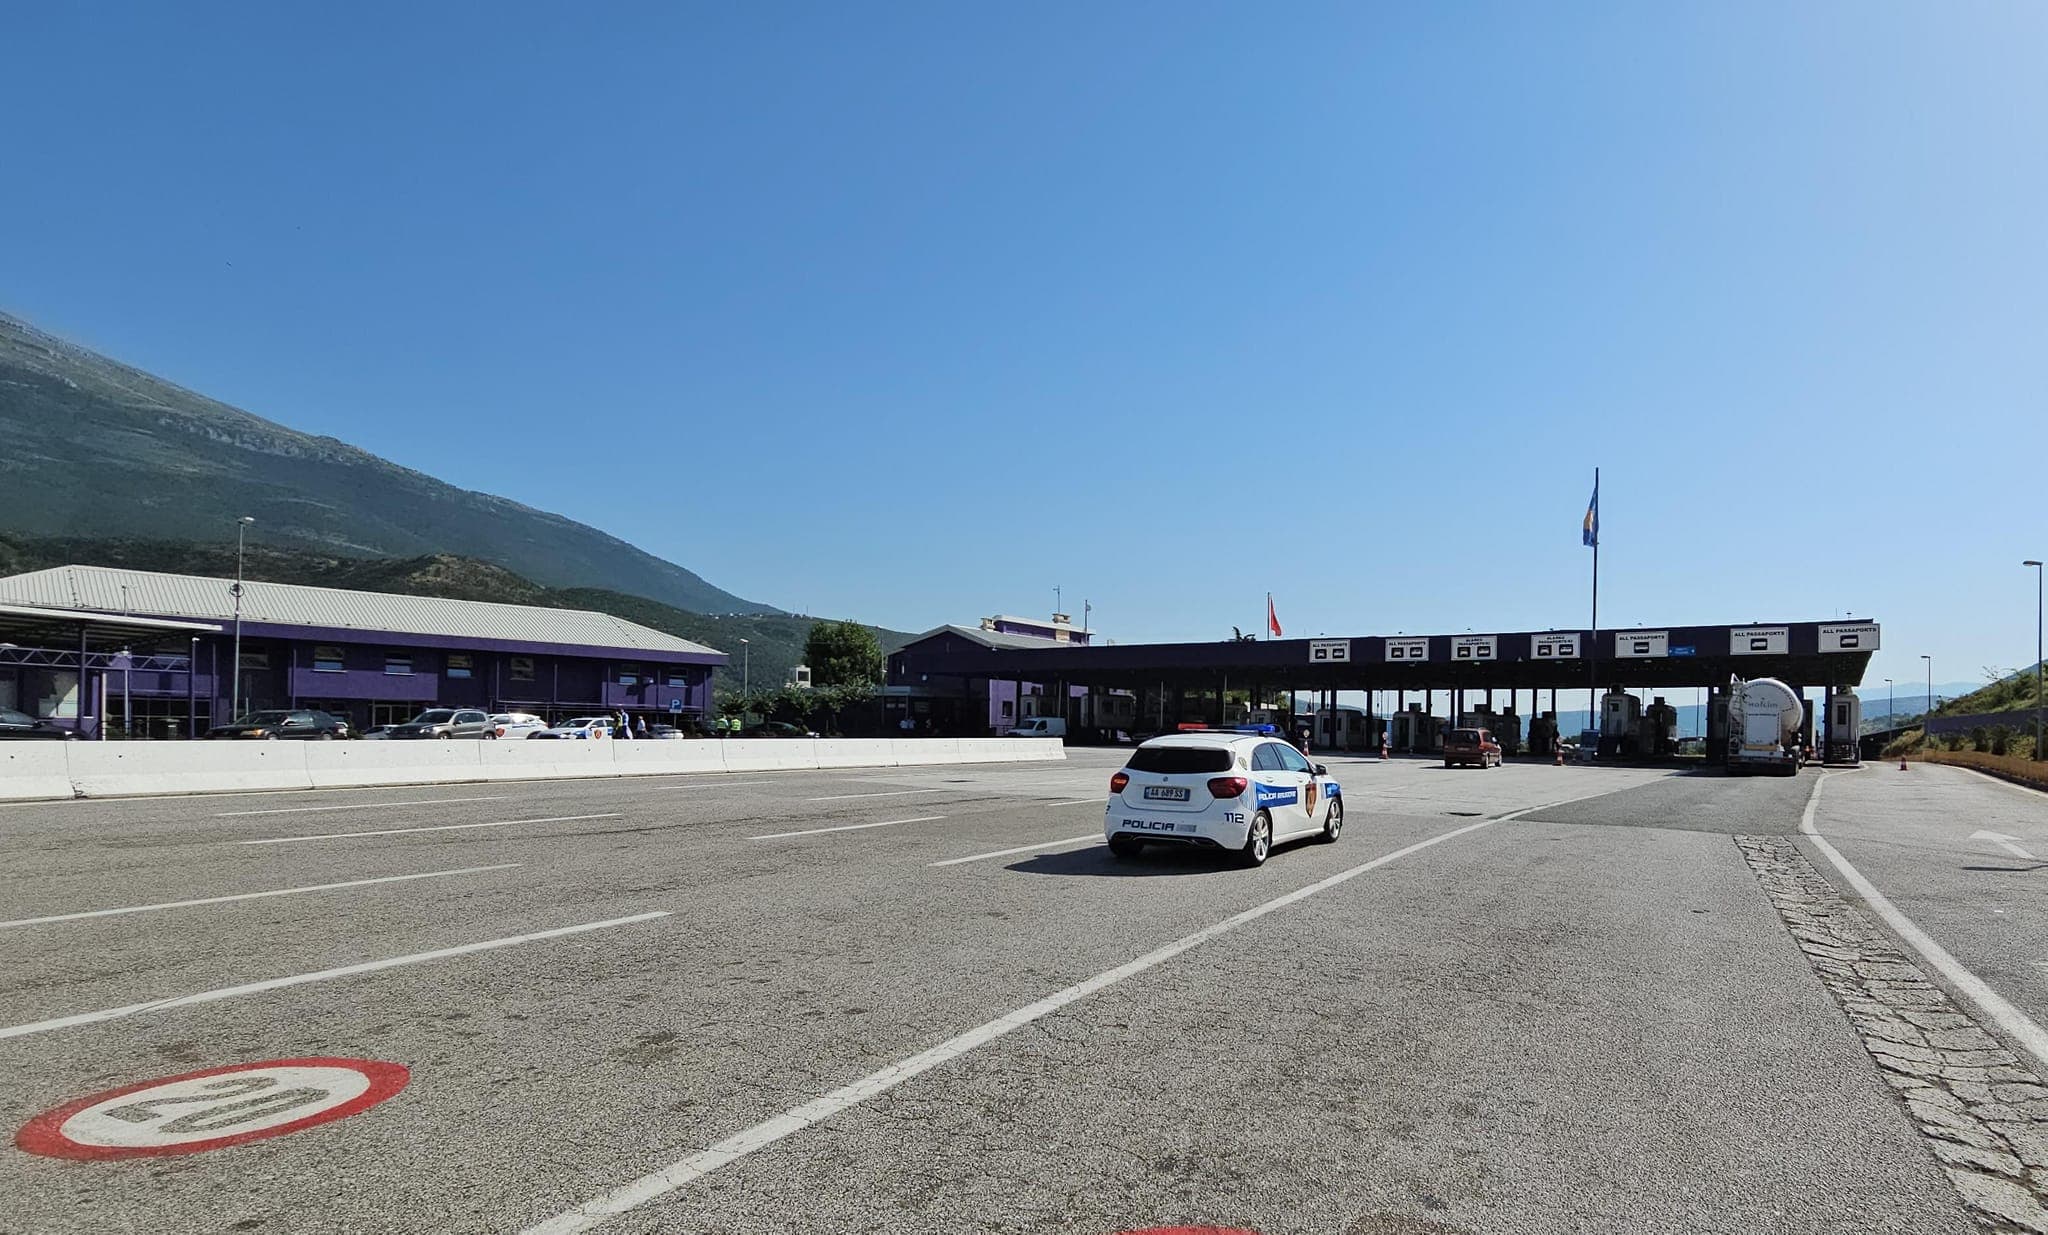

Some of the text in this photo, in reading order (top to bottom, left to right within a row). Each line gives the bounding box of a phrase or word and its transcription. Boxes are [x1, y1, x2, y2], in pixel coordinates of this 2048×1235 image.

[671, 699, 680, 709] P
[1150, 787, 1159, 796] AA
[1223, 812, 1245, 824] 112
[1121, 819, 1175, 832] POLICIA
[100, 1076, 330, 1134] 20
